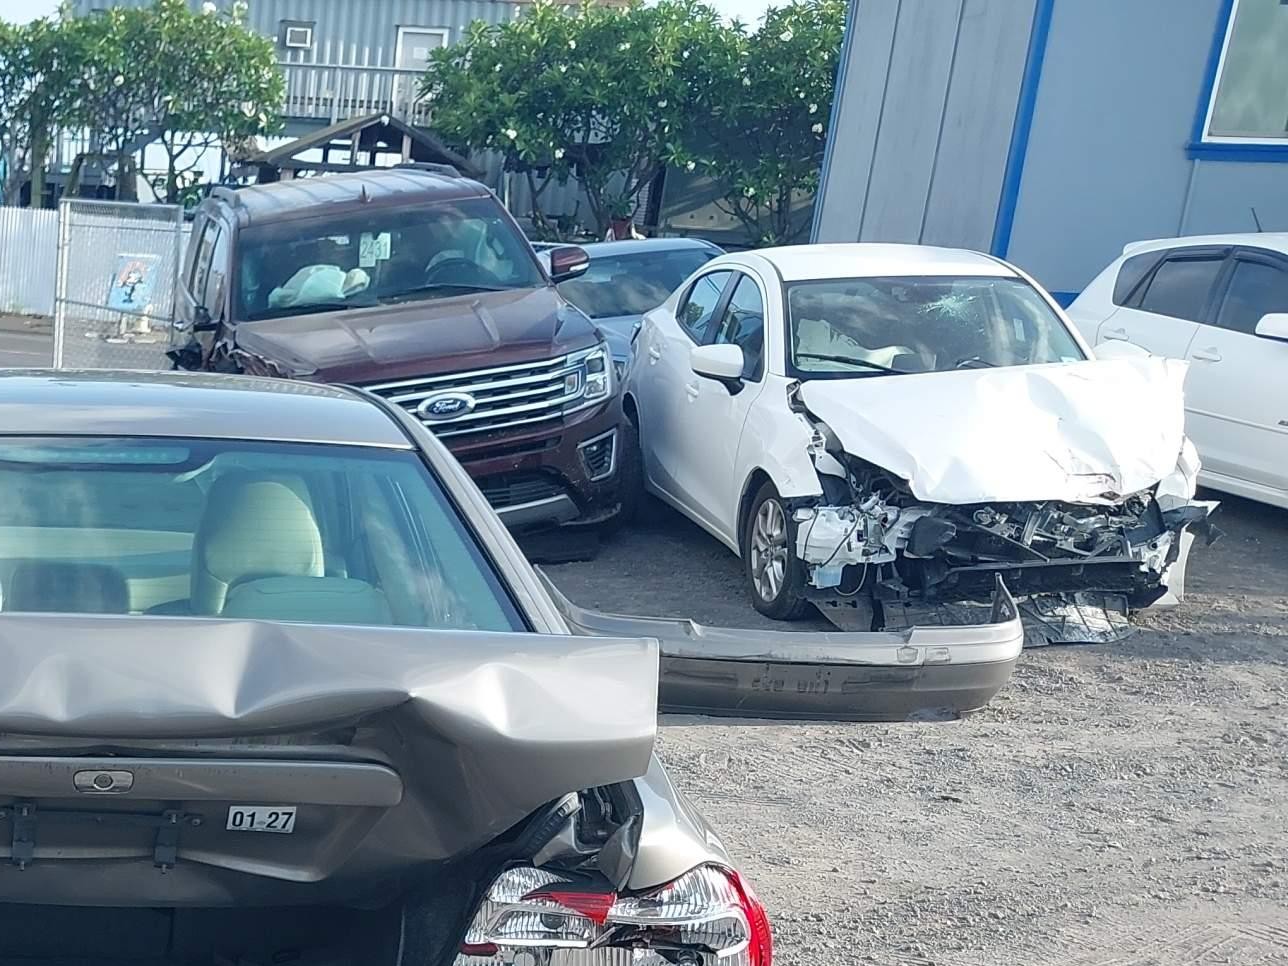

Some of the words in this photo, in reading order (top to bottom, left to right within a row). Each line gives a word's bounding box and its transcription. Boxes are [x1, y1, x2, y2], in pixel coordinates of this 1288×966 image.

[432, 398, 462, 414] Ford
[231, 810, 257, 828] 01
[265, 811, 294, 830] 27
